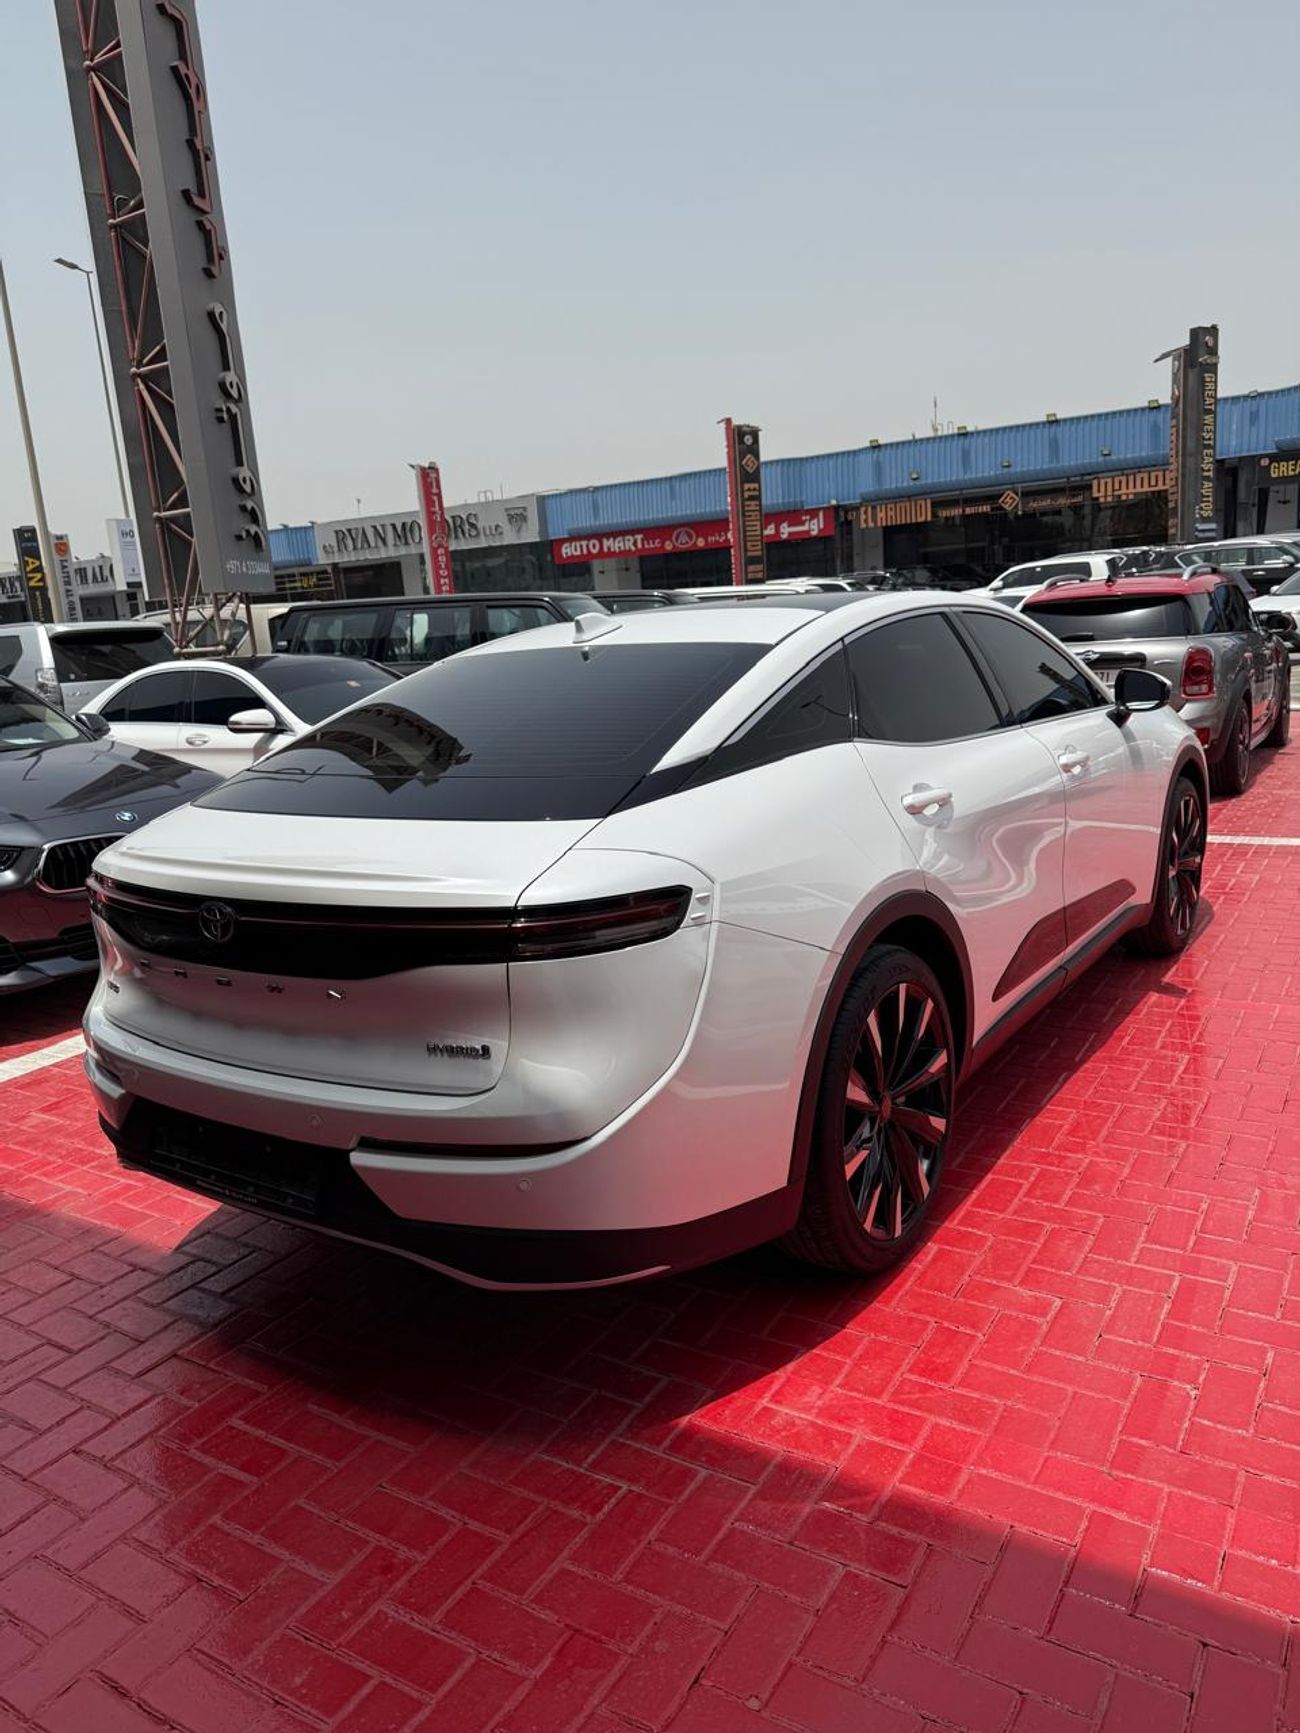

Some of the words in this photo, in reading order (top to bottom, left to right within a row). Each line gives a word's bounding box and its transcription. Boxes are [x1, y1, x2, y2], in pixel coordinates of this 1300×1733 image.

[1203, 373, 1216, 411] GREAT
[1201, 414, 1215, 446] WEST
[1200, 449, 1214, 478] EAST
[860, 507, 876, 529] EL
[877, 498, 931, 527] HAMIDI
[1199, 481, 1213, 518] AUTOS
[334, 523, 388, 552] RYAN
[745, 499, 763, 558] HAMIDI
[561, 537, 600, 557] AUTO
[603, 533, 644, 553] MART
[644, 538, 662, 549] LLC
[24, 556, 44, 588] AN
